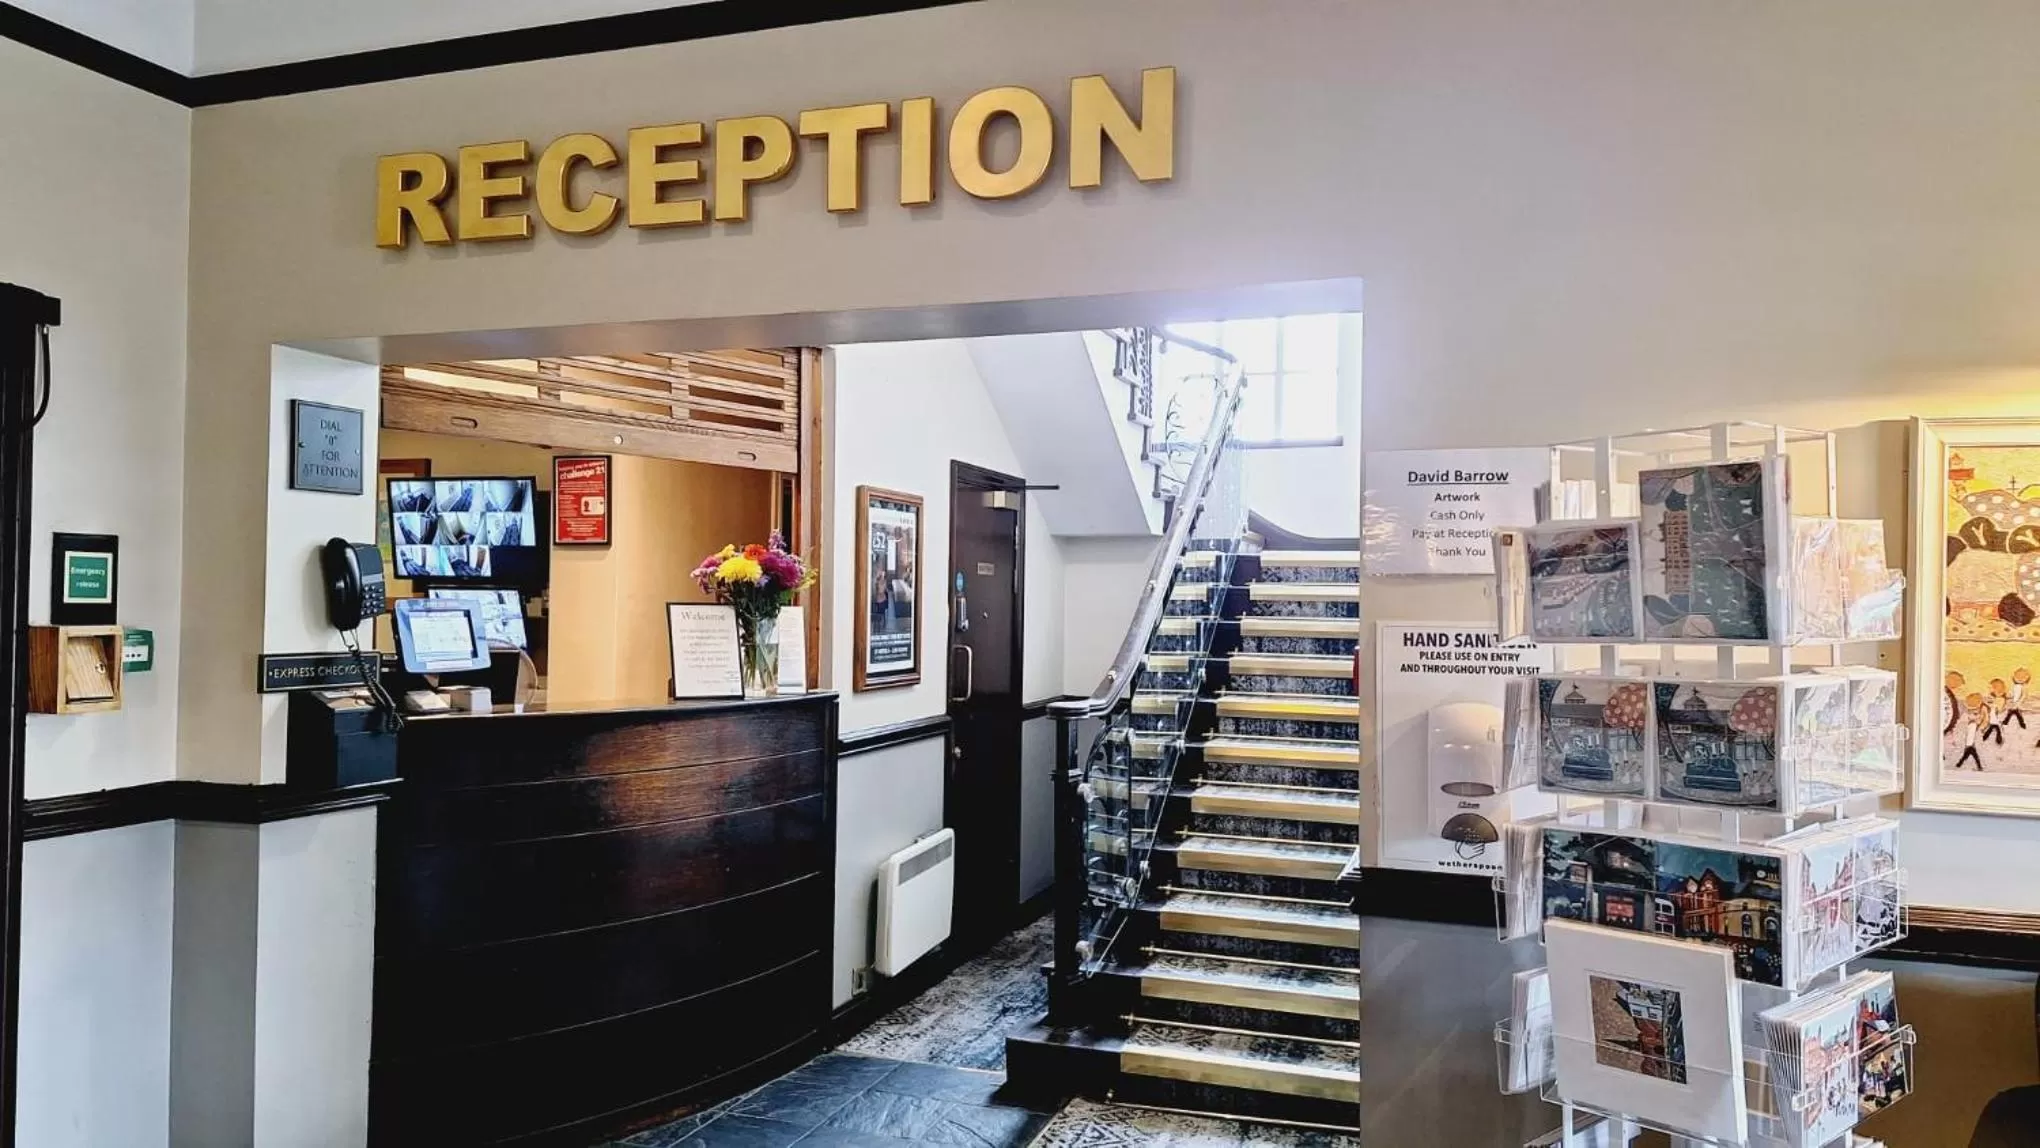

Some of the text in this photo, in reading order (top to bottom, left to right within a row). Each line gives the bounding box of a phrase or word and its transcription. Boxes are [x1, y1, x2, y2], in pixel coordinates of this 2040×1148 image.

[376, 66, 1176, 249] RECEPTION
[320, 419, 342, 432] DIAL
[322, 449, 341, 461] FOR
[303, 463, 359, 478] ATTENTION
[1408, 470, 1509, 485] David Barrow
[1434, 492, 1480, 502] Artwork
[1430, 510, 1485, 522] Cash Only
[1434, 530, 1444, 539] at
[1448, 529, 1494, 541] Recepti
[1466, 547, 1486, 557] You
[71, 567, 105, 576] Emergency
[1403, 632, 1449, 647] HAND
[1419, 651, 1520, 662] PLEASE USE ON ENTRY
[274, 667, 315, 679] EXPRESS
[1400, 663, 1540, 675] AND THROUGHOUT YOUR VISIT
[1438, 860, 1503, 871] wetherspoon
